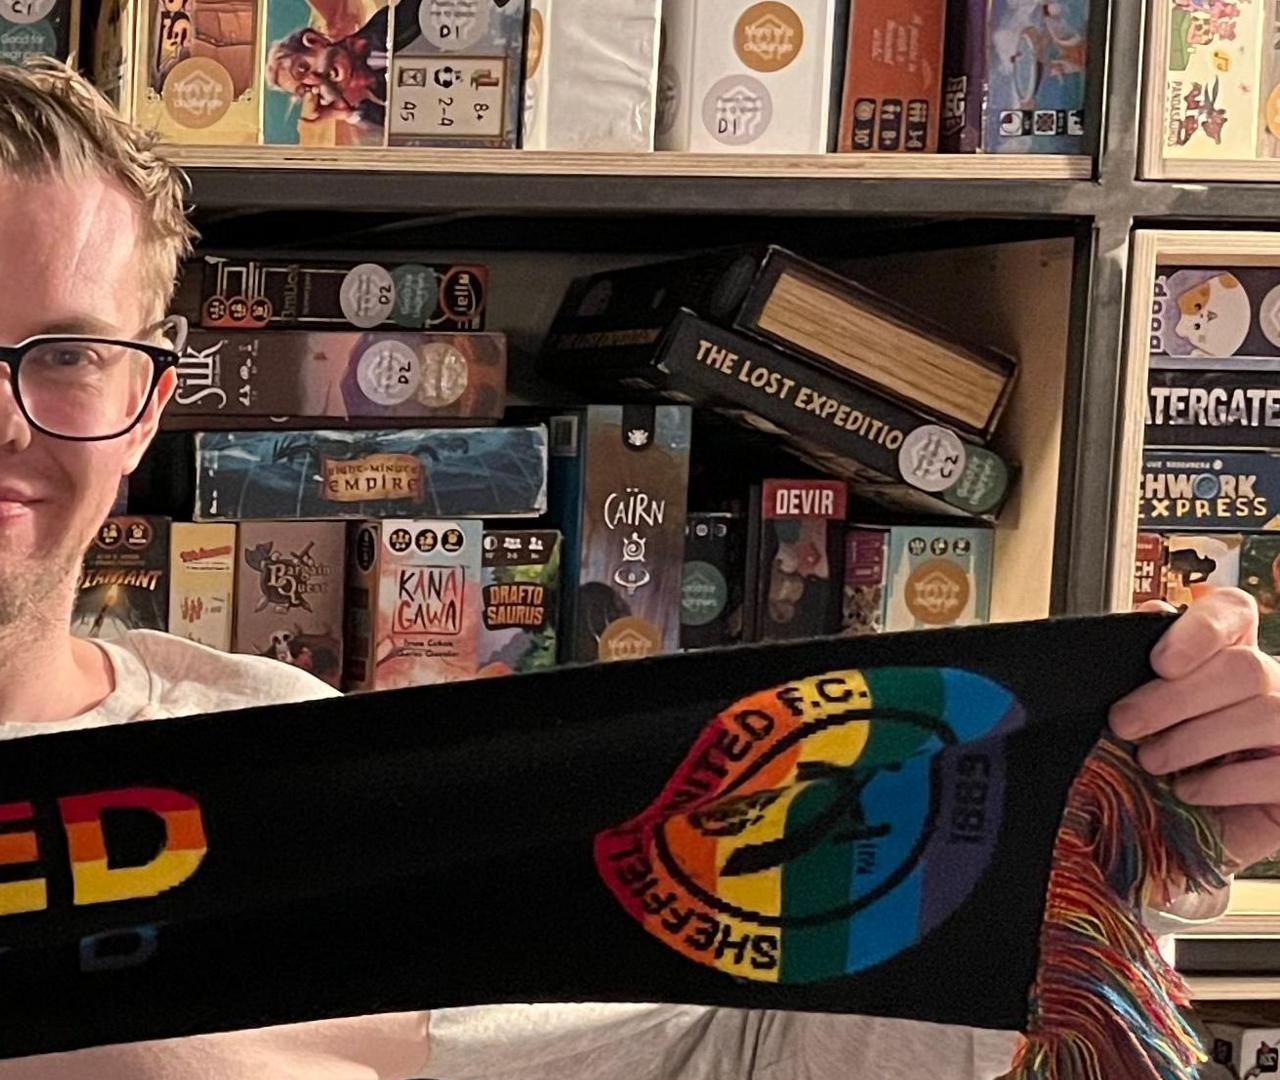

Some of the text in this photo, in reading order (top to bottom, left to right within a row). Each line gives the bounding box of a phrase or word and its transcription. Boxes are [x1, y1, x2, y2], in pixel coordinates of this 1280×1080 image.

[400, 101, 415, 123] 45
[696, 339, 905, 453] THE LOST EXPEDITIO
[328, 473, 419, 493] EMPIRE
[775, 489, 835, 515] DEVIR
[398, 569, 457, 602] KANA
[489, 585, 544, 605] DRAFTO
[397, 600, 458, 631] GAWA
[486, 605, 544, 625] SAURUS
[606, 845, 779, 971] SHEFFIEL
